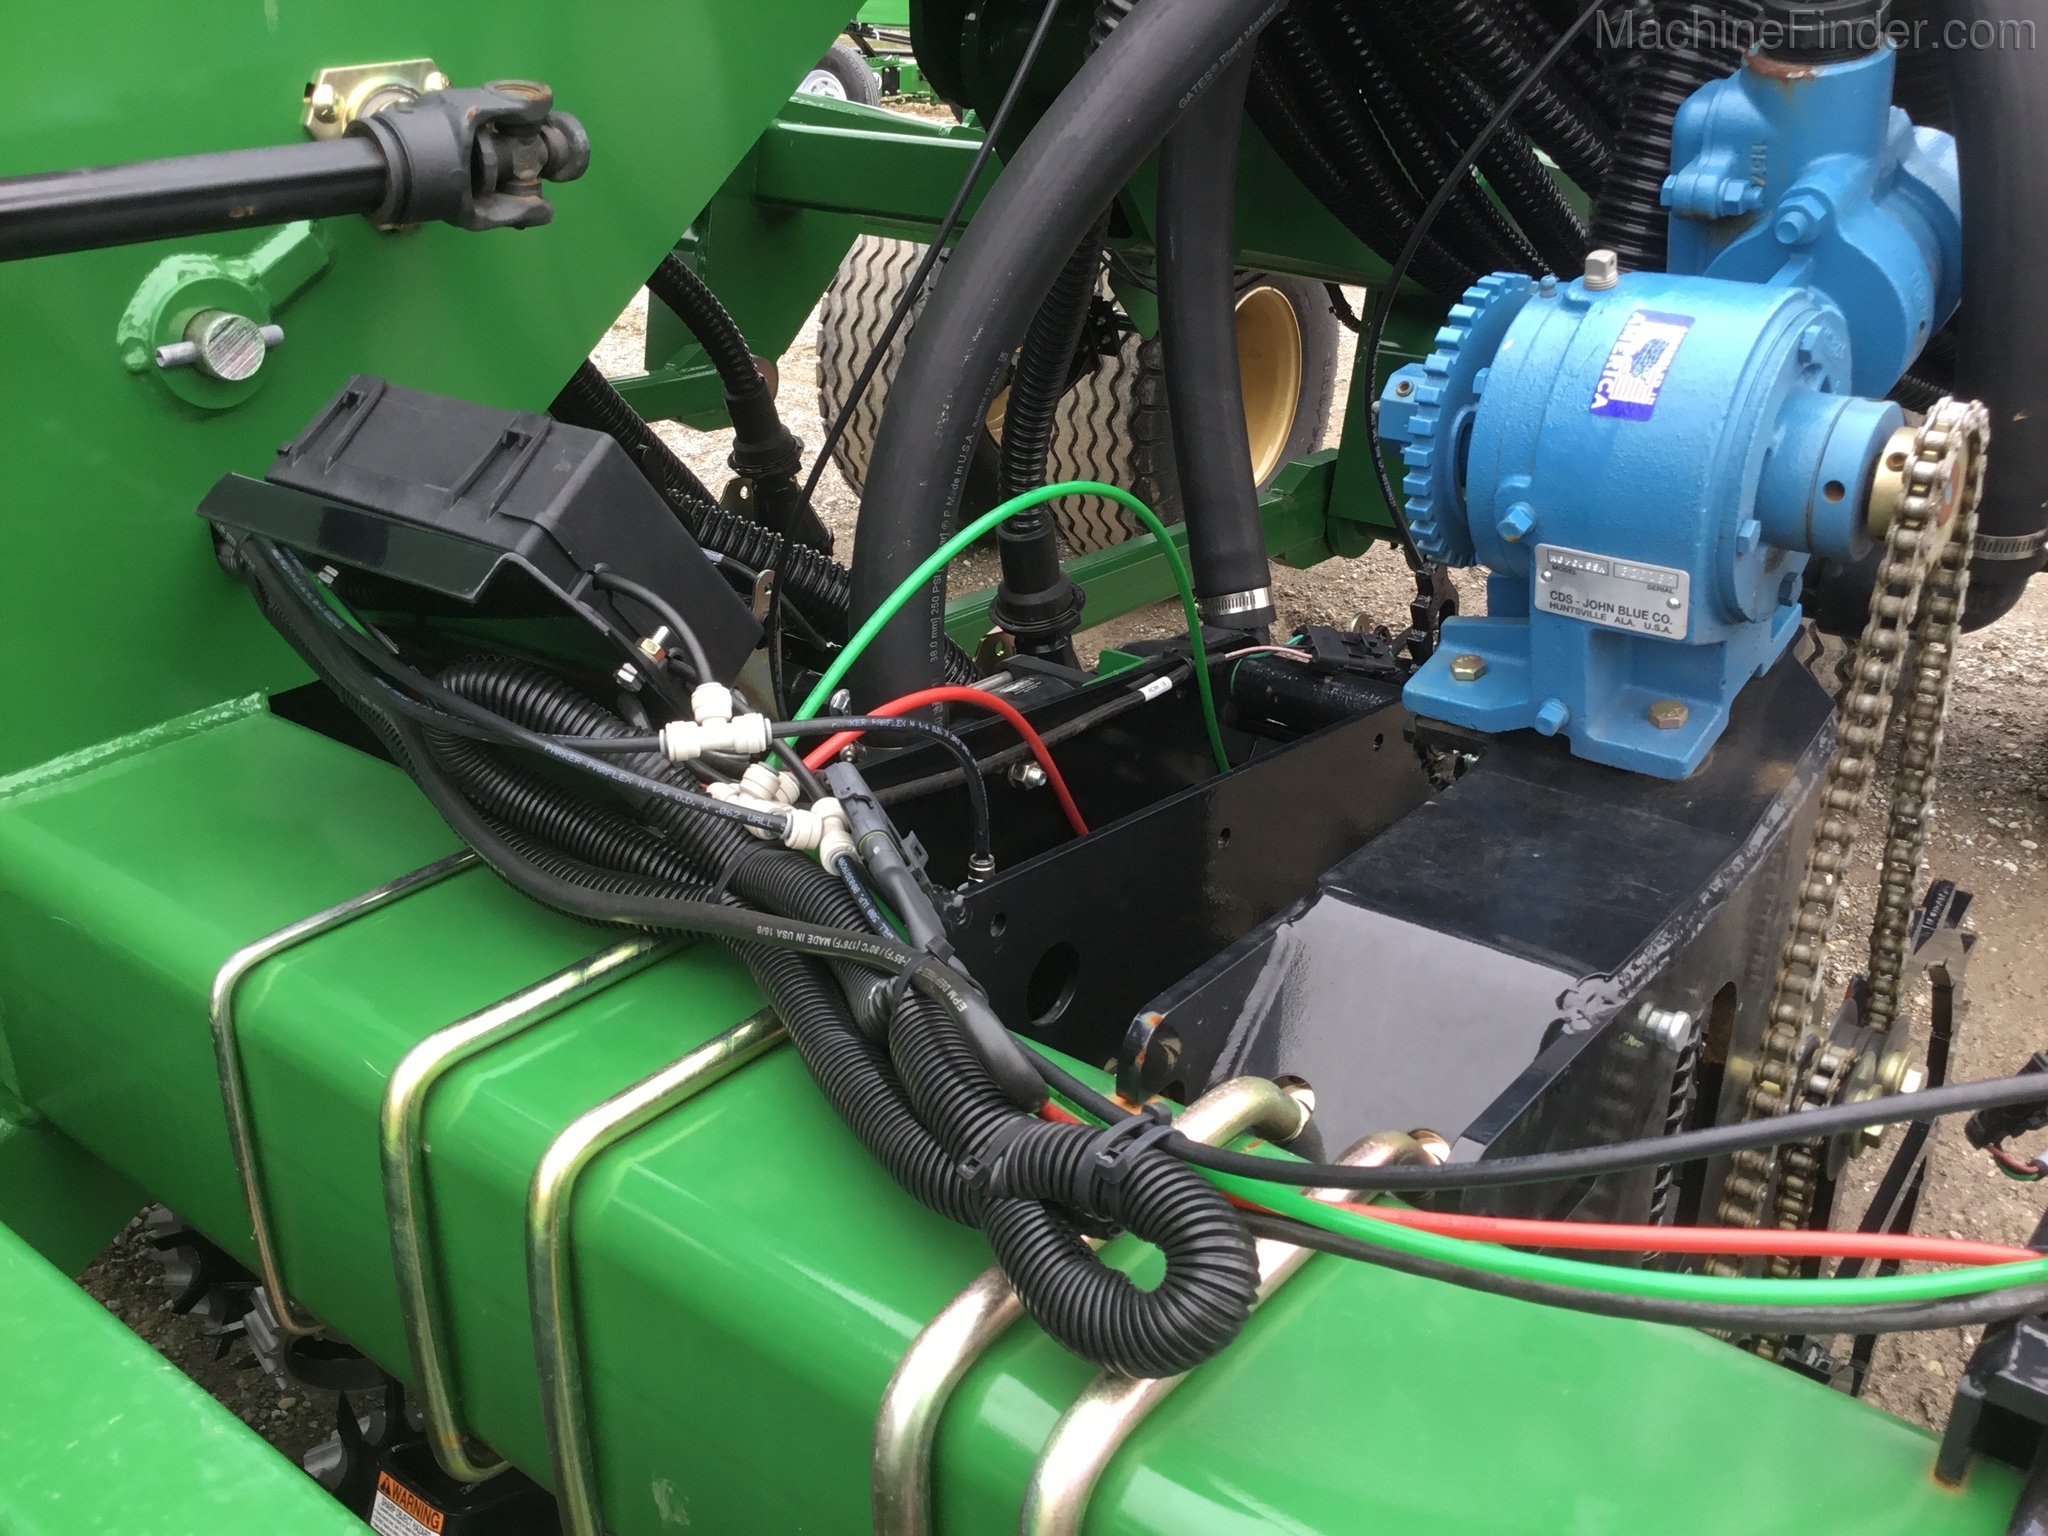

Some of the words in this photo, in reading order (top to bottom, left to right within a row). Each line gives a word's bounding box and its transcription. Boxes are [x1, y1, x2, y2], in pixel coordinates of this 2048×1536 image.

[1219, 36, 1243, 65] Plant
[1590, 311, 1647, 409] AMERICA
[1551, 564, 1578, 576] MODEL
[931, 573, 942, 595] PSI
[1646, 584, 1675, 595] SERIAL
[930, 594, 940, 617] 250
[1550, 590, 1573, 604] CDS
[1583, 598, 1615, 613] JOHN
[1618, 605, 1649, 620] BLUE
[1652, 612, 1674, 626] CO.
[1549, 601, 1607, 621] HUNTSVILLE
[1614, 616, 1636, 628] ALA.
[1644, 622, 1673, 635] U.S.A.
[544, 742, 582, 765] PARKER
[586, 759, 634, 785] PARFLEX
[638, 778, 647, 789] N
[651, 785, 669, 798] 1/4
[674, 791, 697, 807] O.D.
[702, 800, 711, 810] X
[715, 806, 741, 820] .062
[746, 813, 774, 829] WALL
[776, 928, 794, 941] USA
[796, 931, 805, 942] IN
[806, 933, 832, 947] MADE
[832, 937, 860, 951] (176°F)
[946, 989, 968, 1012] EPM
[392, 1481, 440, 1529] WARNING
